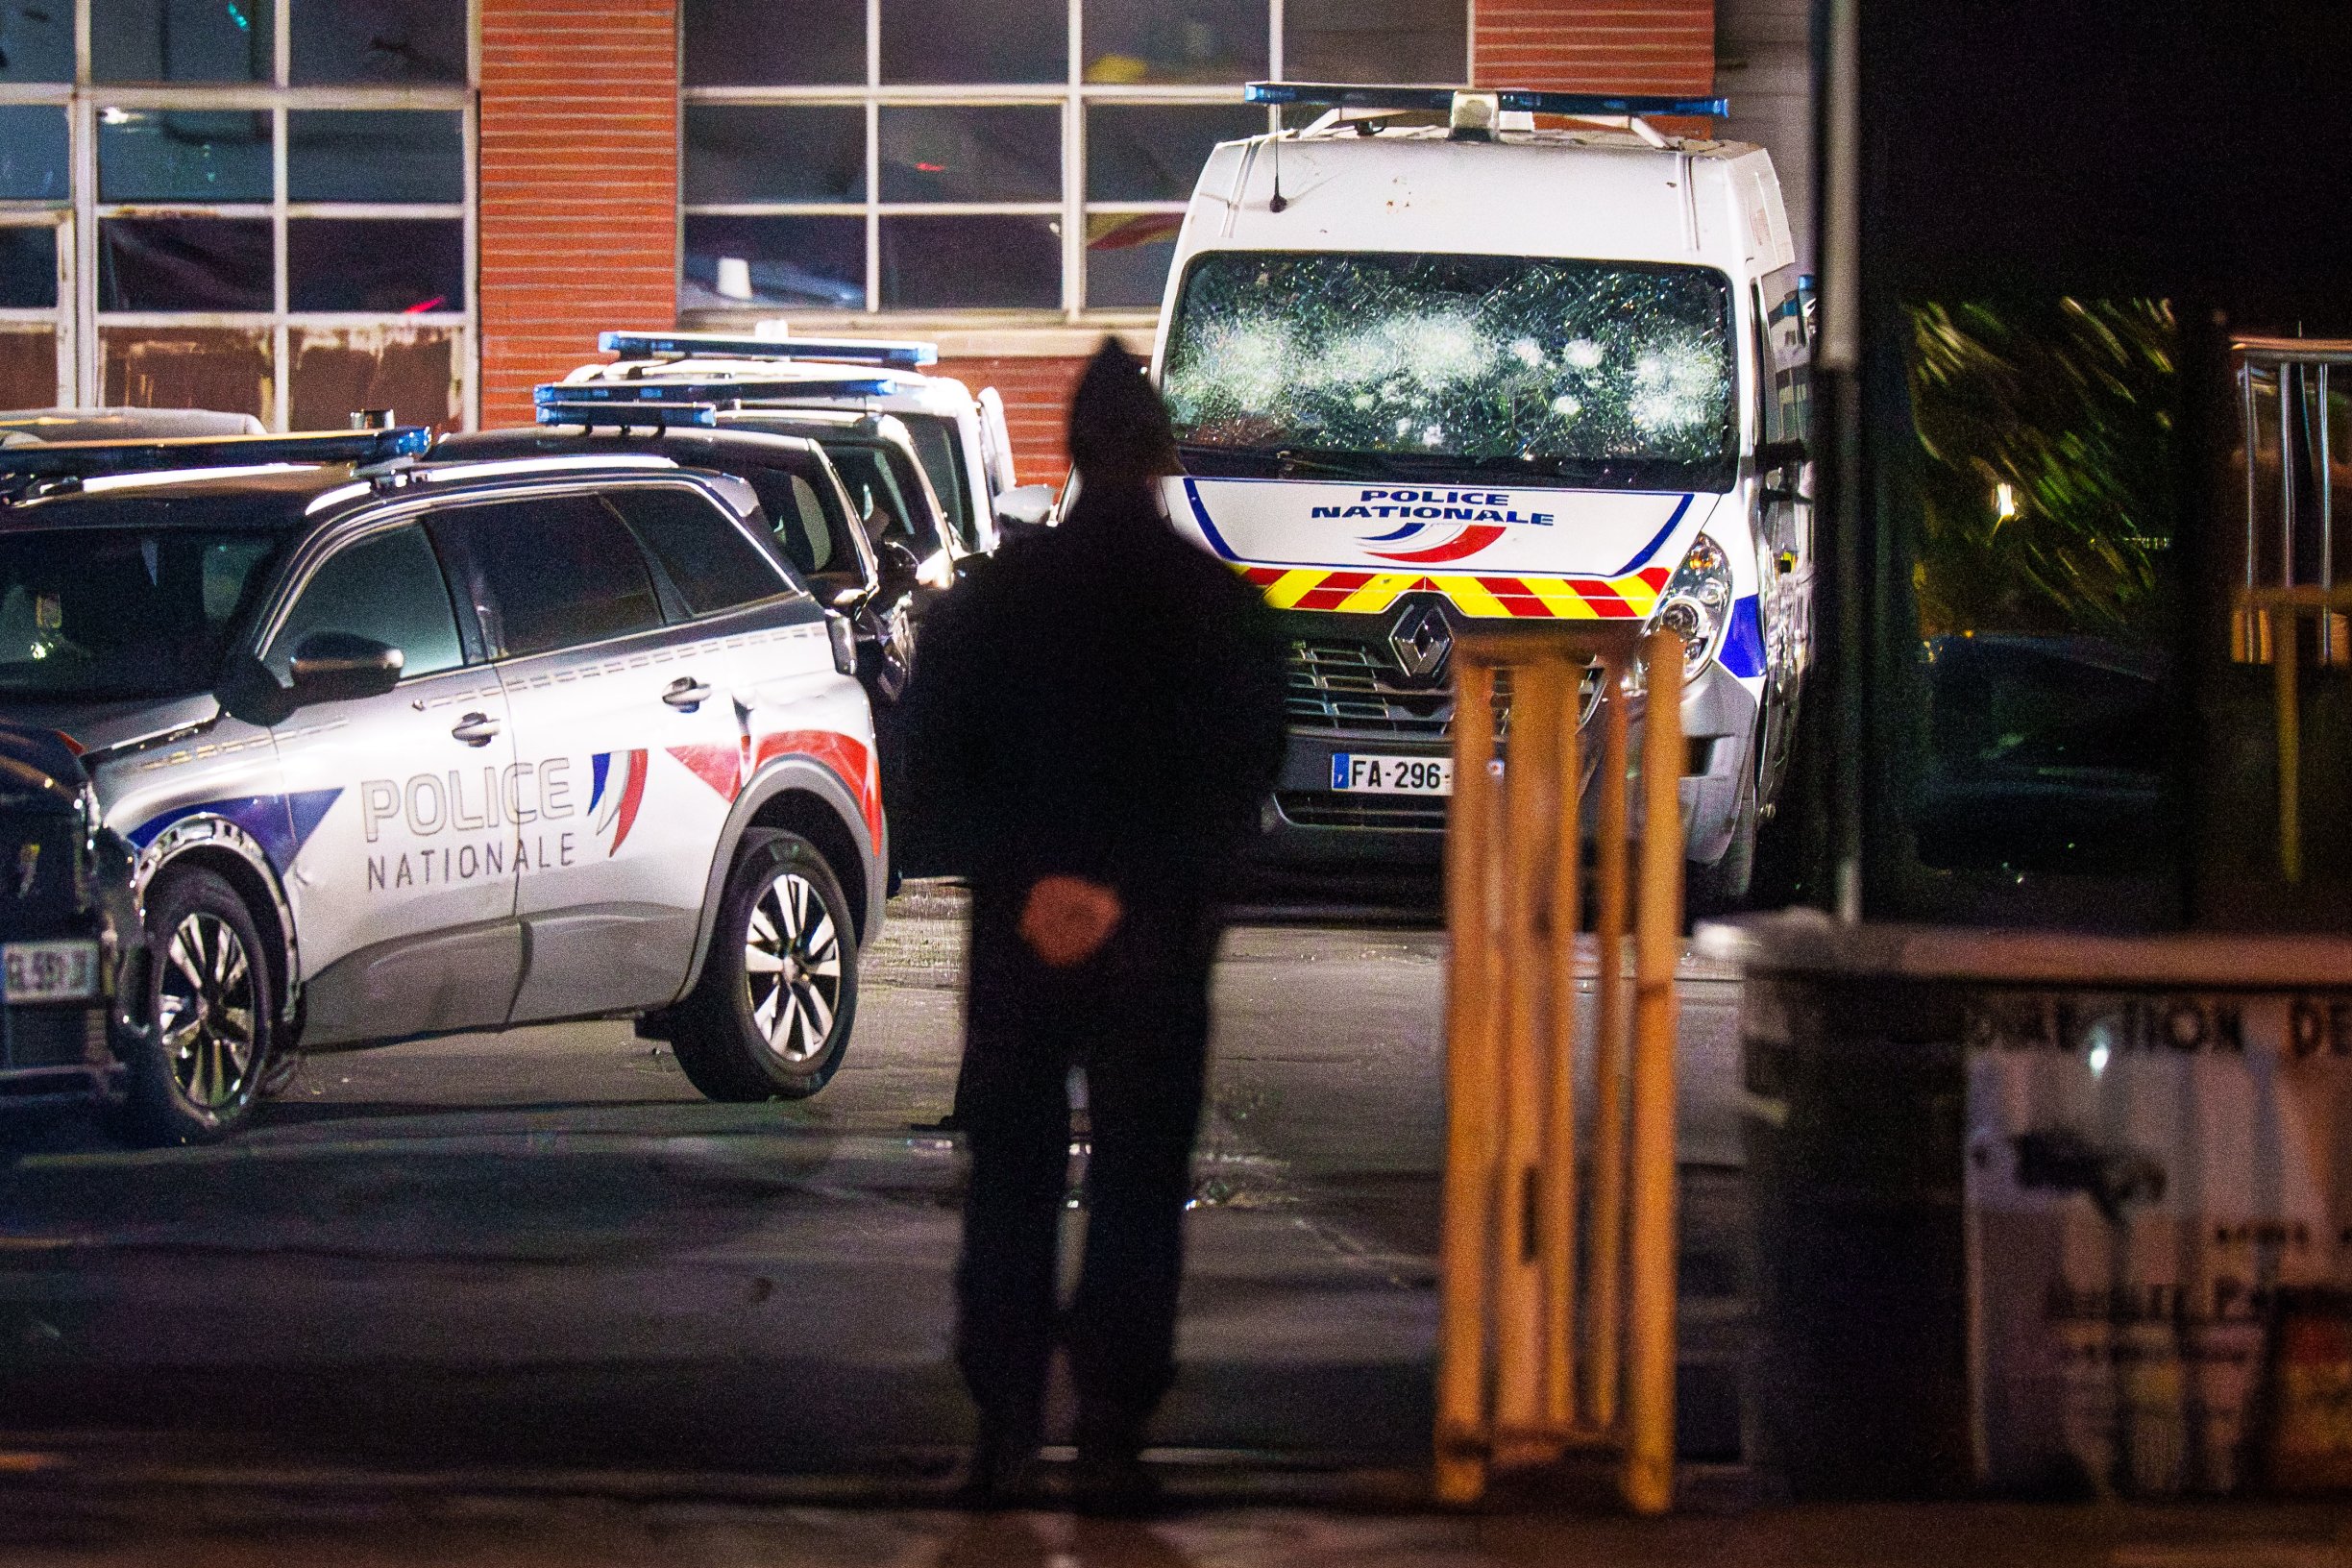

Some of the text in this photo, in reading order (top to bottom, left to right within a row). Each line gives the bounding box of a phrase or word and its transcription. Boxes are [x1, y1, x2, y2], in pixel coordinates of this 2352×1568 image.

[1311, 505, 1555, 526] NATIONALE
[1360, 490, 1509, 506] POLICE
[361, 757, 575, 843] POLICE
[368, 833, 575, 891] NATIONALE
